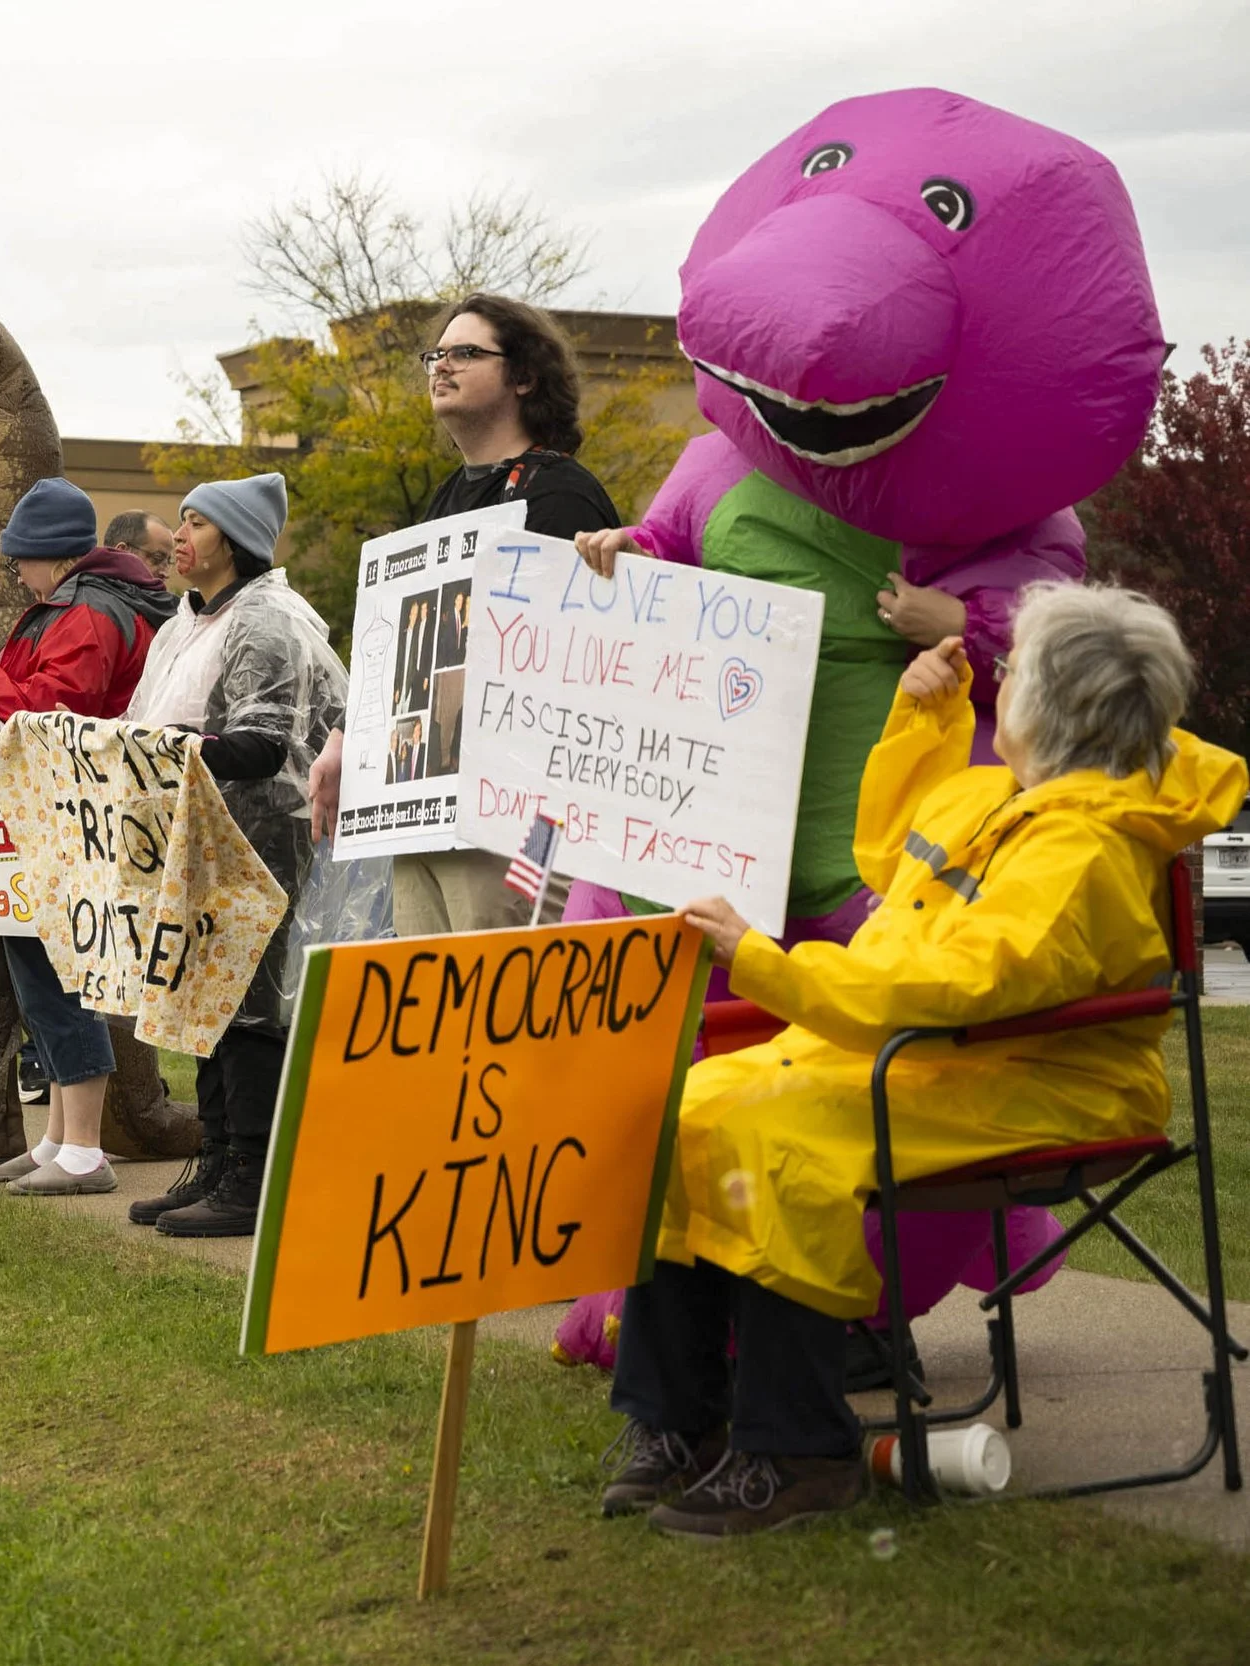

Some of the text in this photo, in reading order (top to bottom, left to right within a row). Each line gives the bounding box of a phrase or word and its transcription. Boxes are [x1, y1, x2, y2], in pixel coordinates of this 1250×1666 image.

[367, 564, 378, 583] if
[384, 550, 427, 580] ignorance
[438, 541, 450, 559] is
[489, 544, 541, 604] I
[560, 550, 674, 625] LOVE
[485, 606, 706, 702] YOU LOVE ME
[636, 727, 727, 777] HATE
[355, 809, 379, 830] knock
[379, 808, 394, 827] the
[395, 804, 422, 824] smile
[423, 801, 441, 821] off
[565, 802, 600, 845] BE
[342, 927, 683, 1064] DEMOCRACY
[358, 1136, 588, 1301] KING
